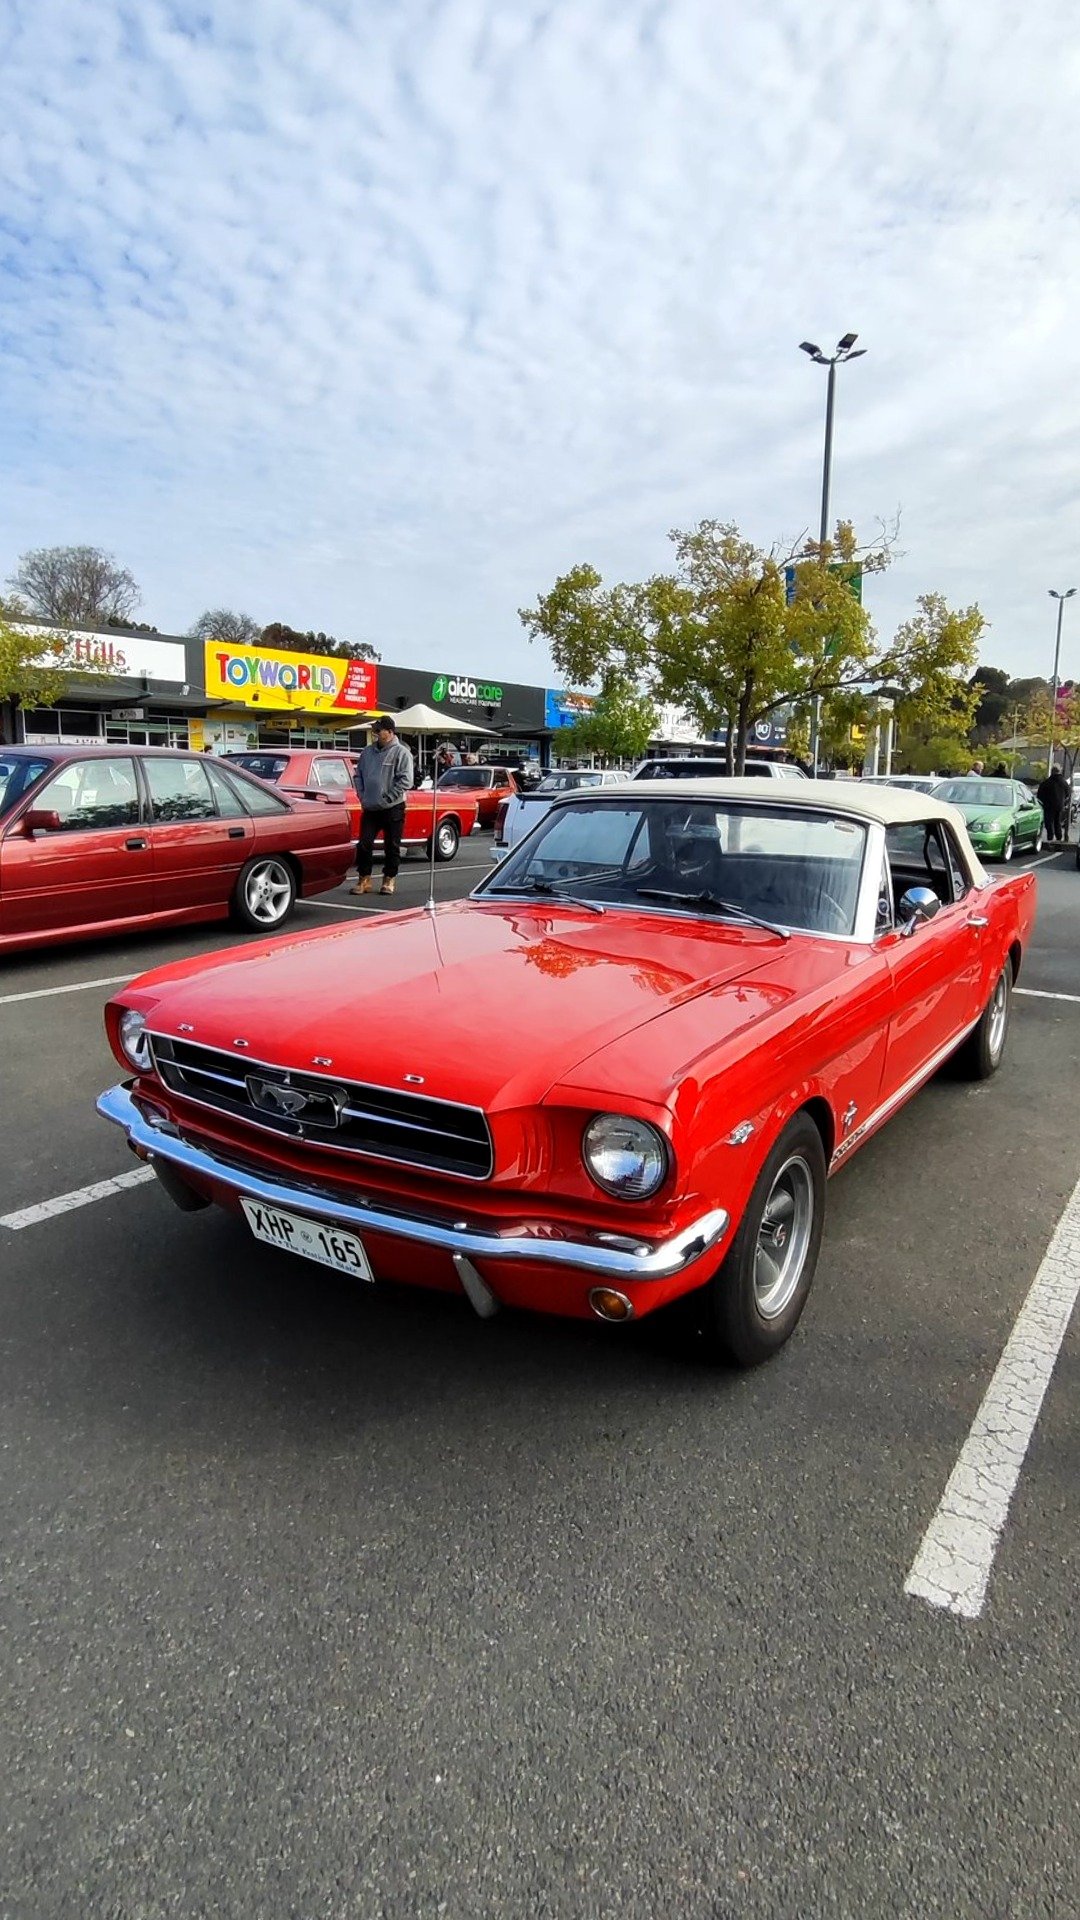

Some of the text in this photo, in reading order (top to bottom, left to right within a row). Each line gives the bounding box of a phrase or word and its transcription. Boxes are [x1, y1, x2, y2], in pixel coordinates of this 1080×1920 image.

[75, 638, 126, 665] Hills
[217, 653, 335, 692] TOYWORLD
[249, 1206, 361, 1268] XHP 165
